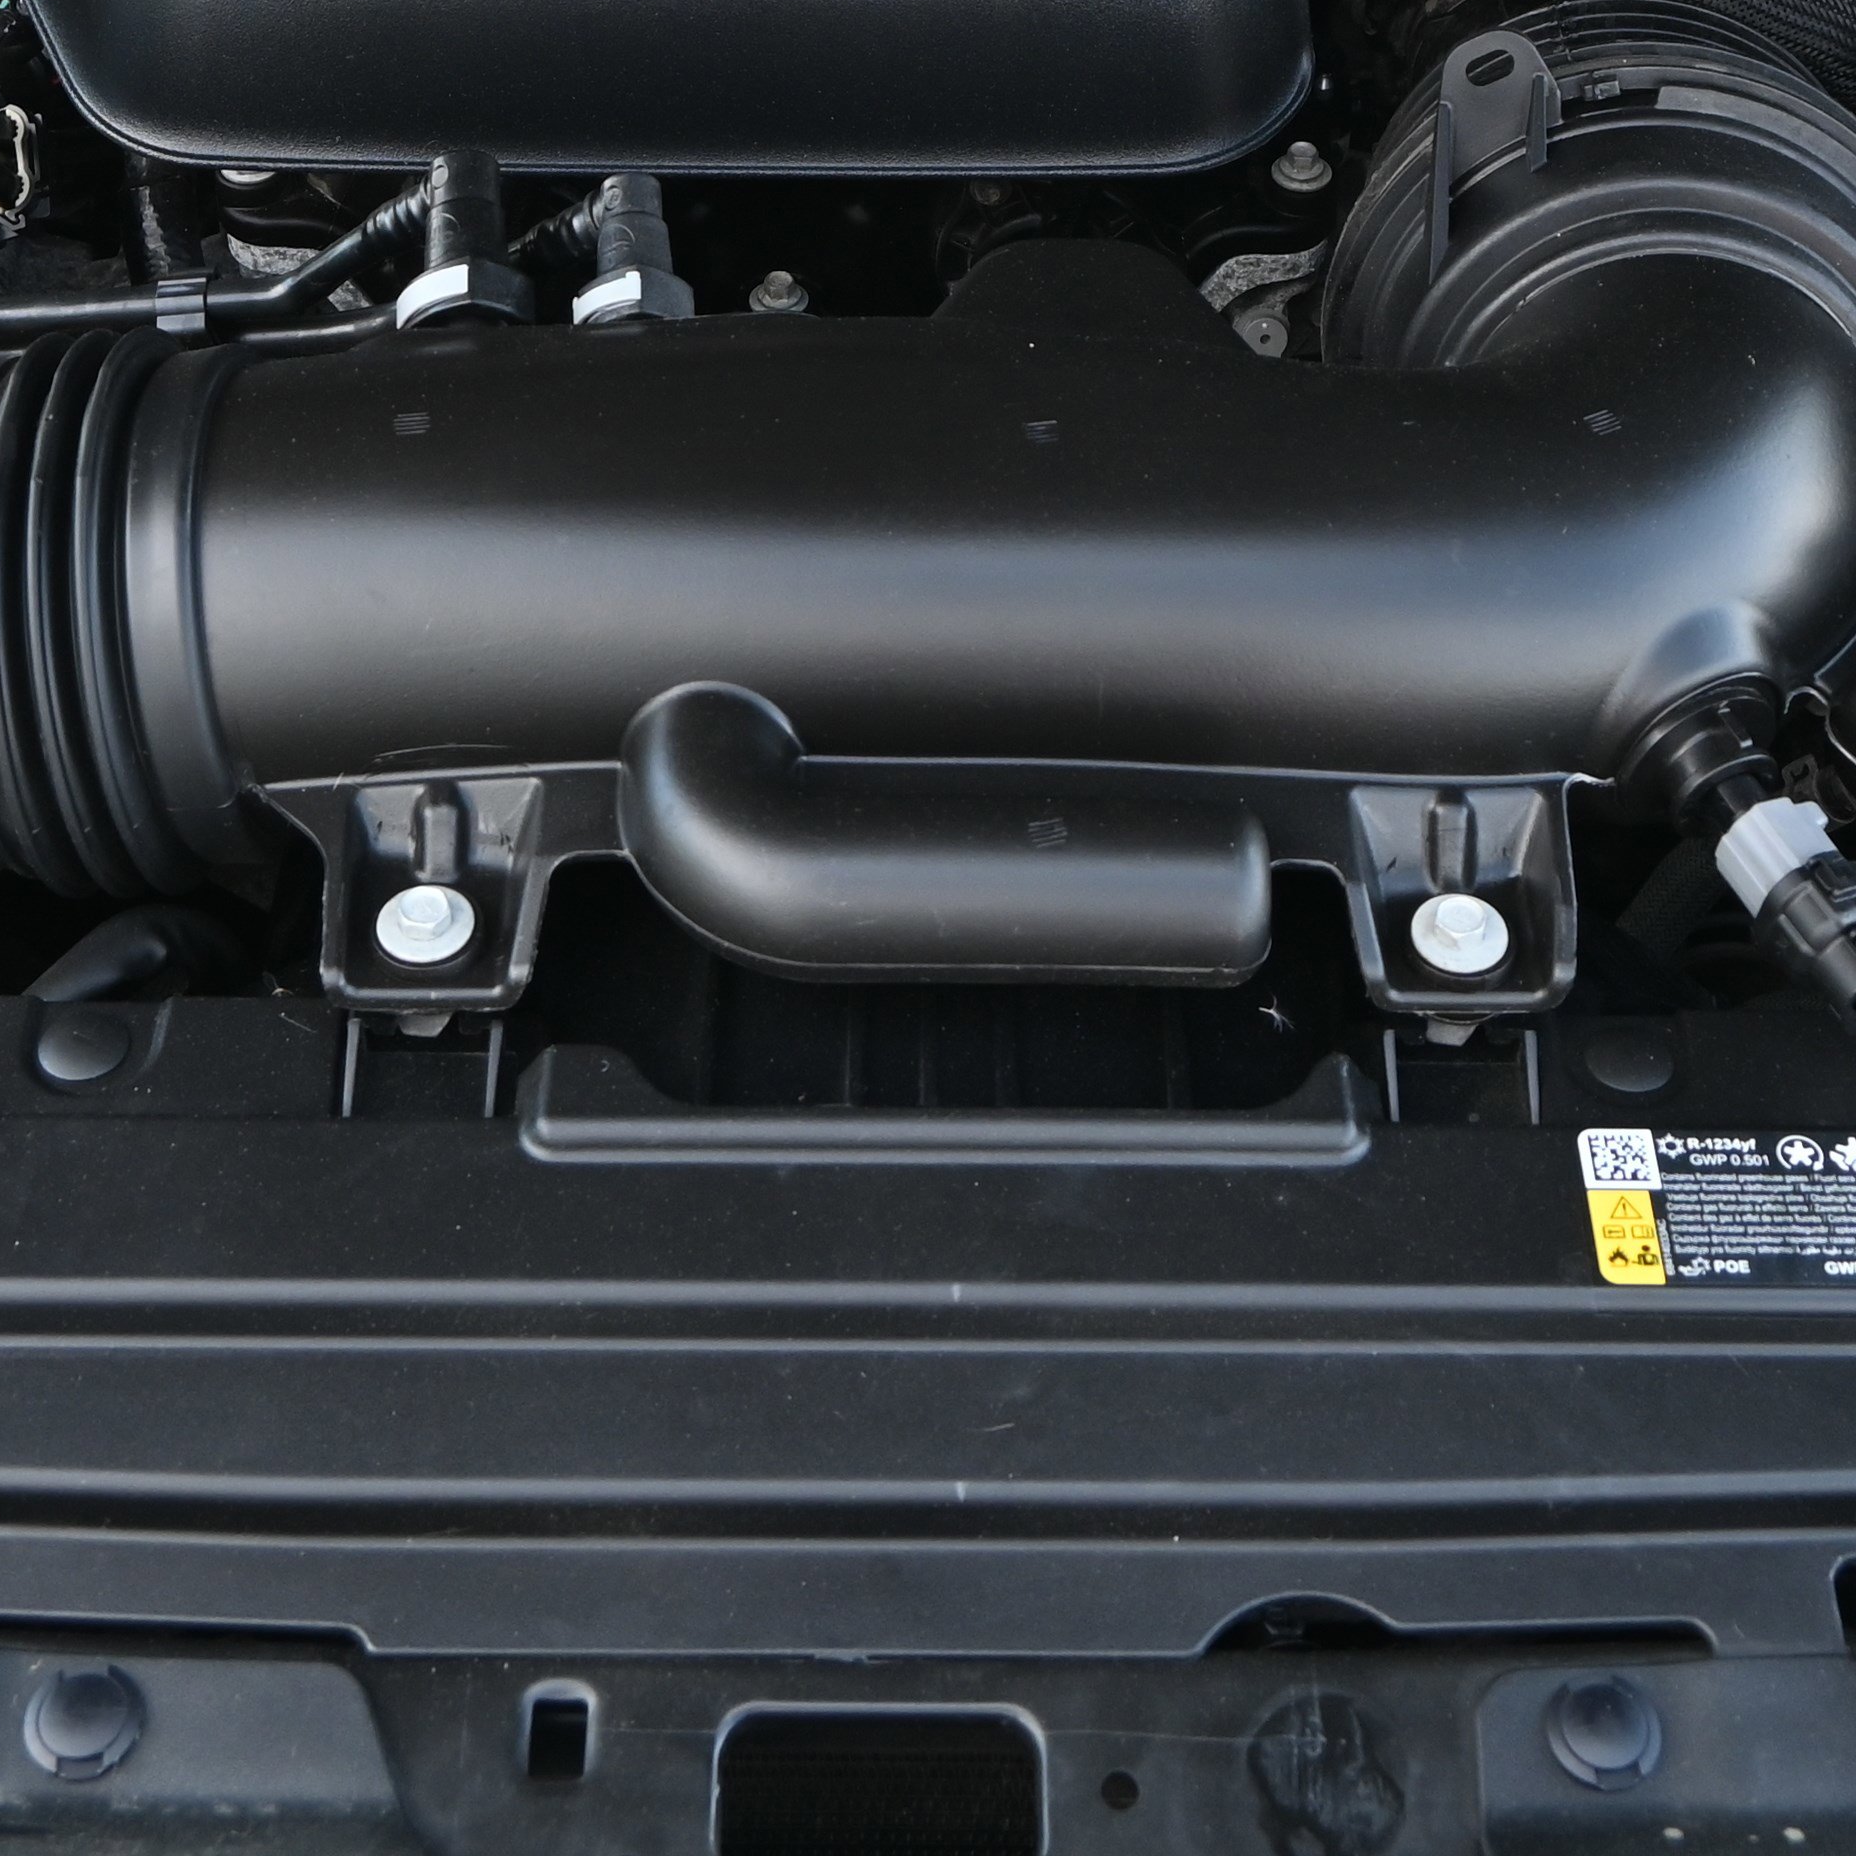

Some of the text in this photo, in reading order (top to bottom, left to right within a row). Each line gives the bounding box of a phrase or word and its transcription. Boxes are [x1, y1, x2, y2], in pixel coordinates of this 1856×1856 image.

[1686, 1137, 1757, 1154] R-1234yf
[1690, 1153, 1727, 1167] GWP
[1729, 1153, 1770, 1167] 0.501
[1713, 1260, 1751, 1275] POE
